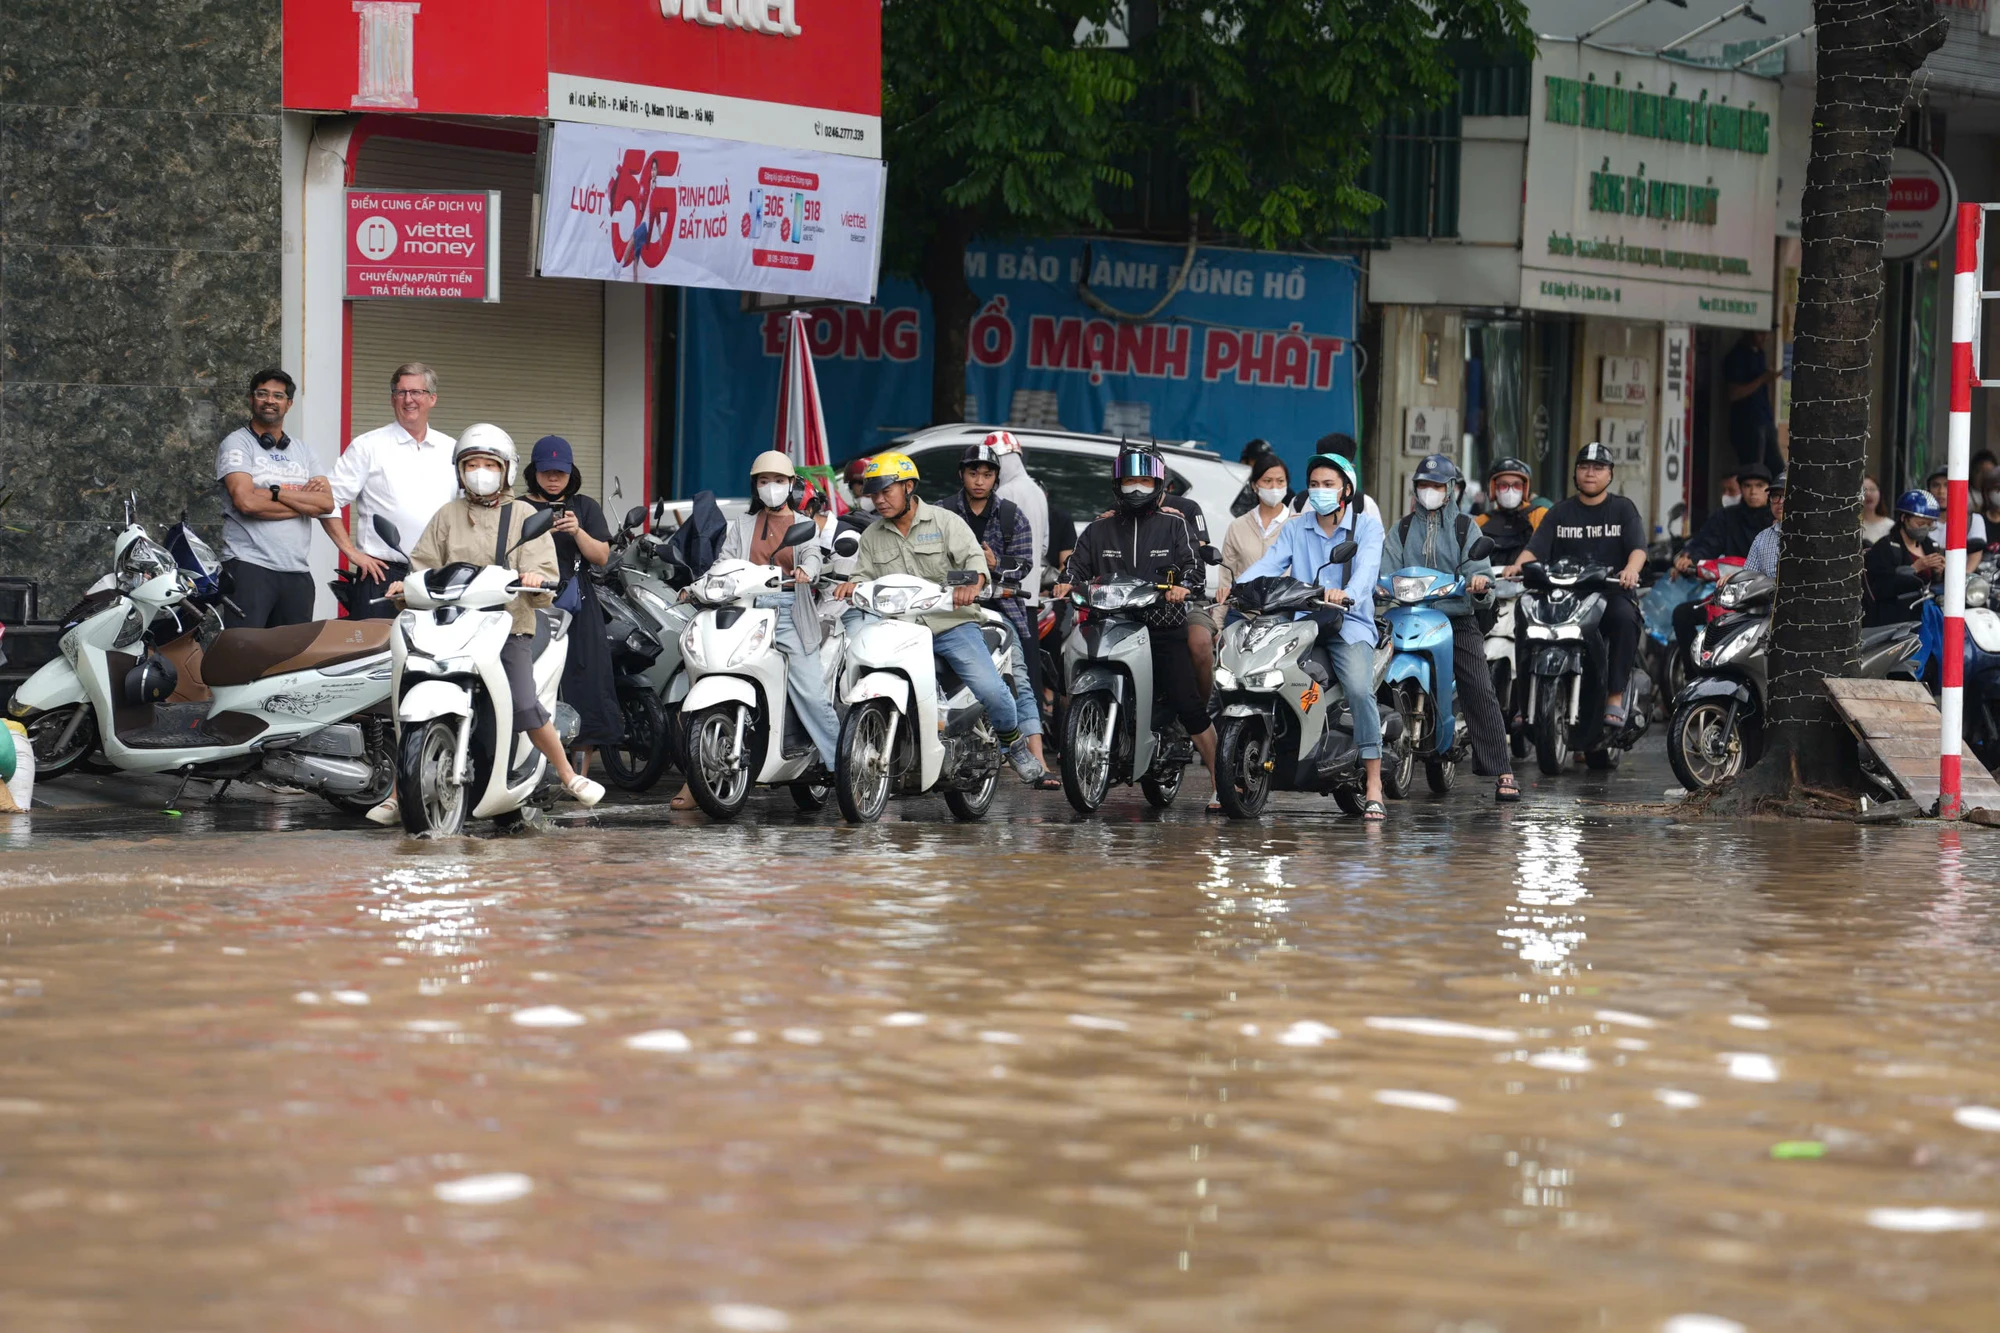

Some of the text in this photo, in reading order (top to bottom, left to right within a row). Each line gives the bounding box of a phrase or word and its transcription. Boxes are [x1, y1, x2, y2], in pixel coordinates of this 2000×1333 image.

[578, 95, 586, 107] 41
[570, 183, 606, 215] LƯỚT
[679, 178, 730, 207] RINH QUÀ
[351, 195, 482, 213] ĐIỂM CUNG CẤP DỊCH VỤ
[611, 149, 679, 268] 5G
[764, 195, 784, 217] 306
[804, 200, 821, 221] 918
[404, 222, 473, 238] viettel
[678, 209, 727, 239] BẤT NGỜ
[841, 211, 866, 229] viettel
[404, 241, 476, 258] money
[997, 246, 1059, 282] BẢO
[450, 271, 472, 283] TIỀN
[370, 283, 461, 296] TRẢ TIỀN HÓA ĐƠN
[965, 295, 1015, 366] Ồ
[1028, 313, 1192, 384] MẠNH
[1203, 322, 1343, 390] PHÁT
